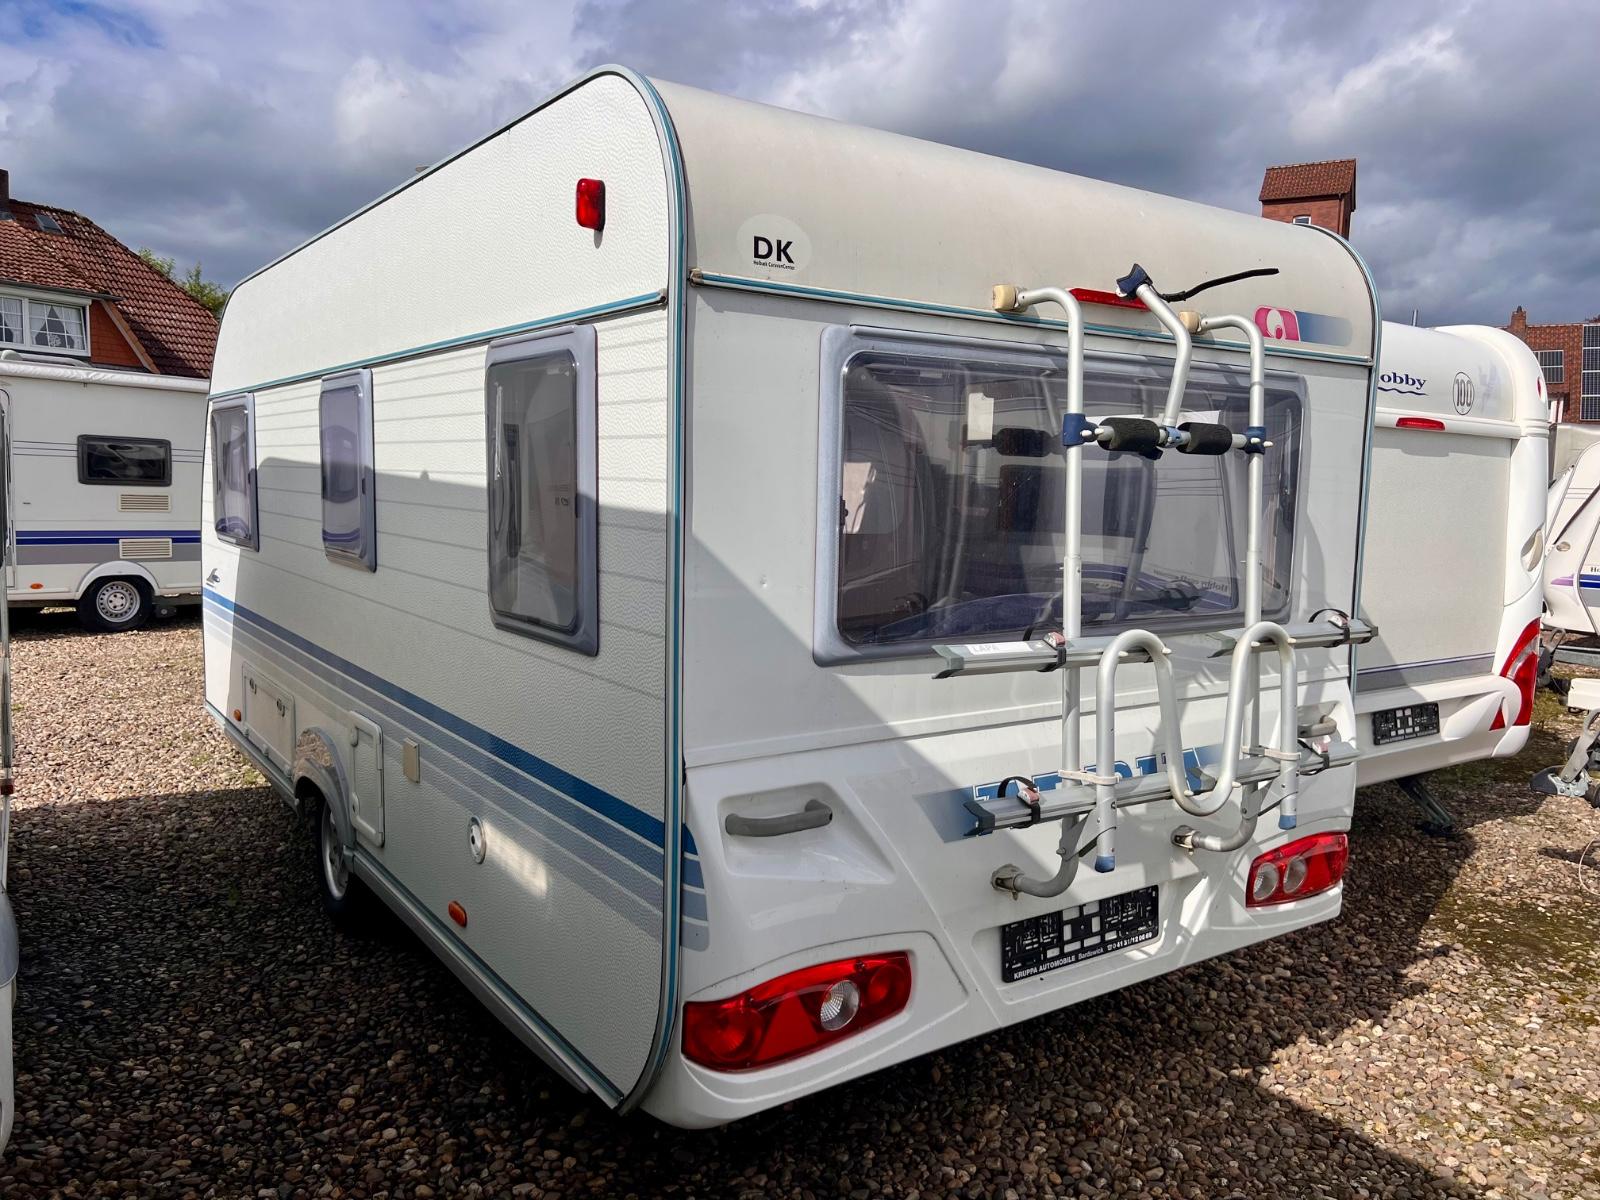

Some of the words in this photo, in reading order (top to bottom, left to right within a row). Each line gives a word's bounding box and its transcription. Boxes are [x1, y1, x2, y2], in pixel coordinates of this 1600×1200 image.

[753, 235, 795, 264] DK
[1380, 371, 1427, 390] obby
[1455, 379, 1472, 407] 100
[1014, 964, 1038, 980] KRUPPA
[1039, 955, 1076, 972] AUTOMOBILE
